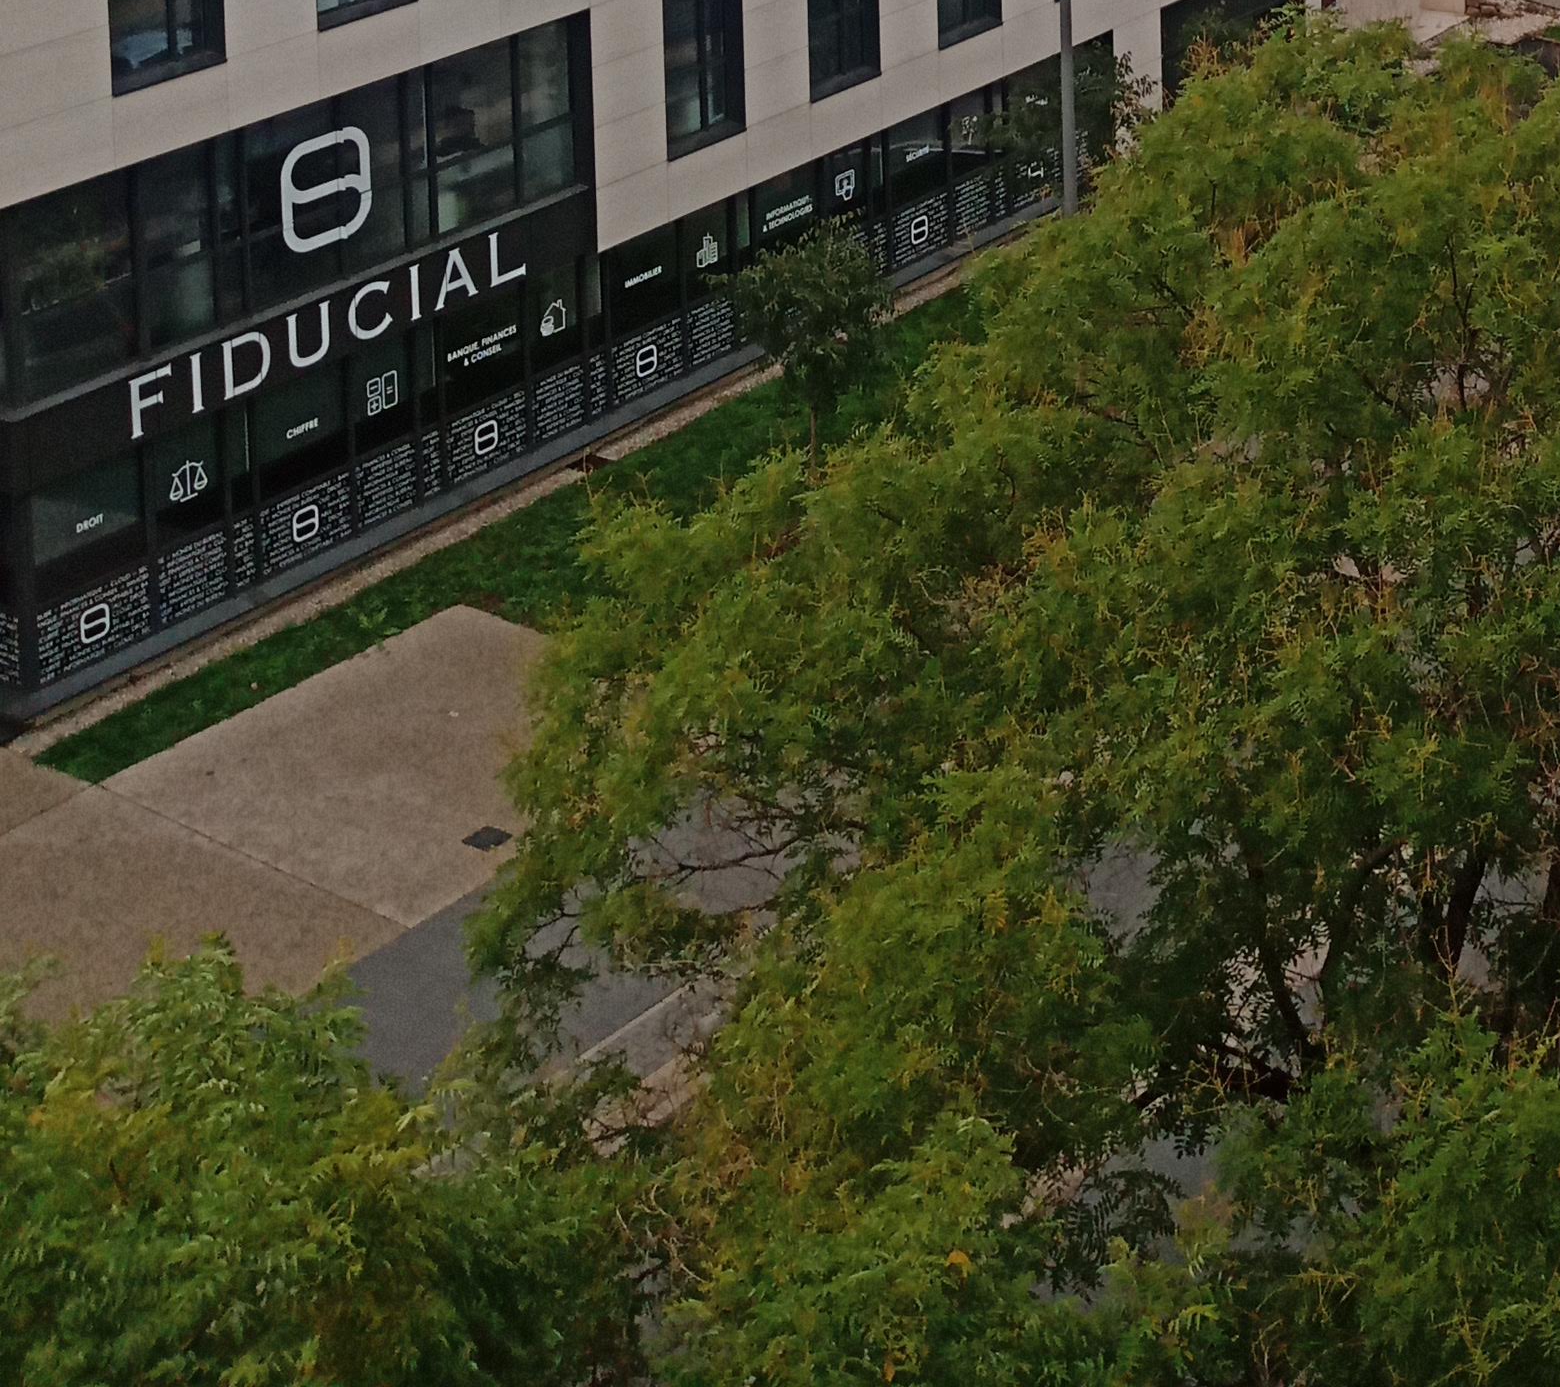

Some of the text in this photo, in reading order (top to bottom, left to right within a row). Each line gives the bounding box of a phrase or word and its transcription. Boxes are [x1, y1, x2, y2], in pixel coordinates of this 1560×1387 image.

[624, 265, 662, 288] IMMOBILIER
[128, 231, 527, 439] FIDUCIAL
[481, 324, 517, 347] FINANCES
[470, 343, 502, 364] CONSEIL
[286, 417, 319, 439] CHIFFRE
[76, 512, 104, 534] DROIT
